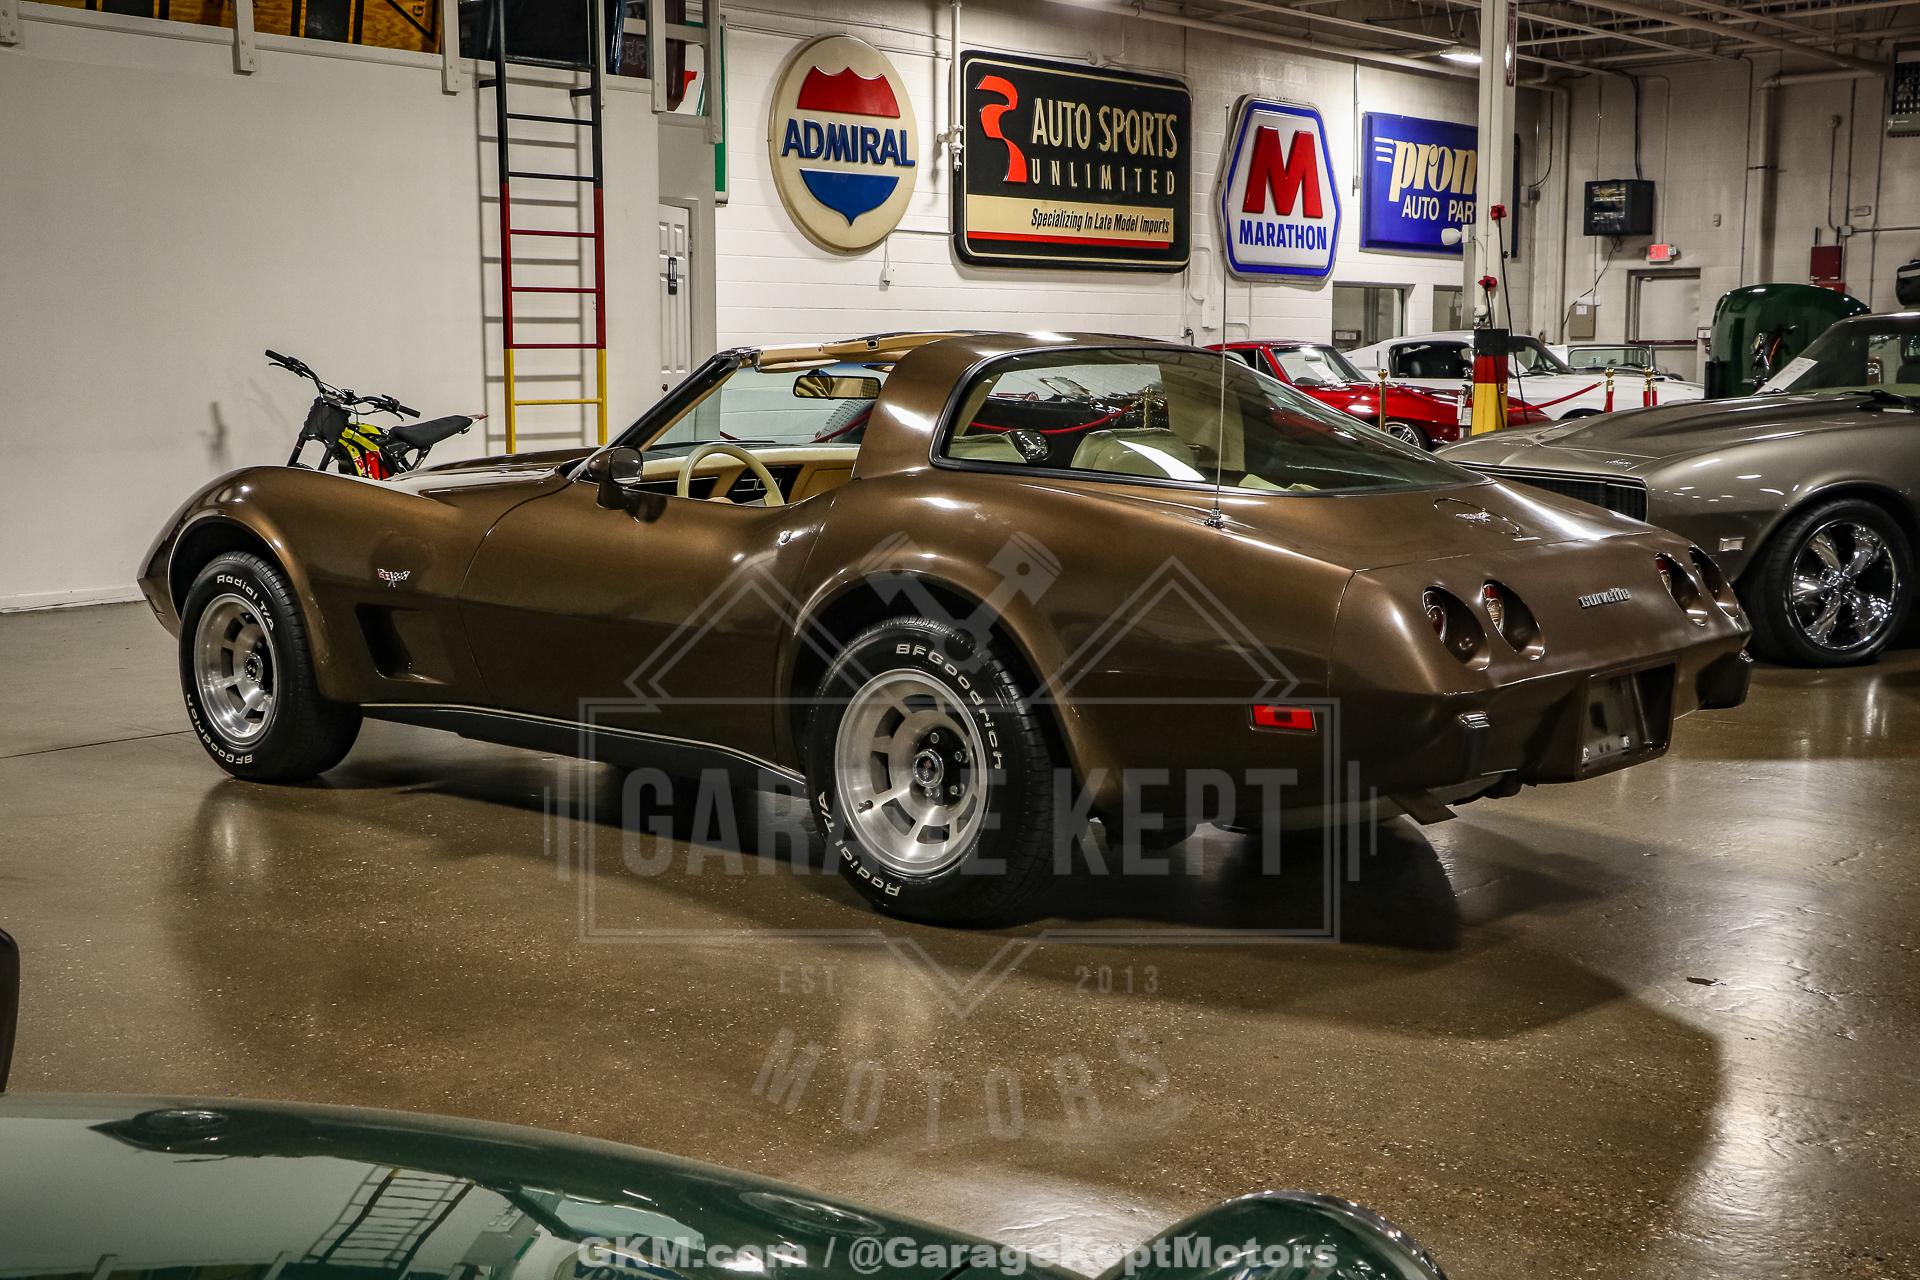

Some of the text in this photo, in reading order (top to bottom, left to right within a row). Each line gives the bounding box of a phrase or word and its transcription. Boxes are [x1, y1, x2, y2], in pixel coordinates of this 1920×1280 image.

[782, 118, 915, 167] ADMIRAL
[1032, 97, 1178, 159] AUTO SPORTS
[1031, 158, 1175, 195] UNLIMITED
[1388, 140, 1477, 203] pron
[1031, 207, 1169, 236] Specializing In Late Model Imports
[1239, 219, 1327, 250] MARATHON
[1401, 195, 1477, 223] AUTO PAR
[217, 574, 275, 632] Radial T/A
[186, 693, 253, 764] BFGoodrich
[896, 644, 1002, 769] BFGoodrich
[818, 791, 901, 897] Radial T/A
